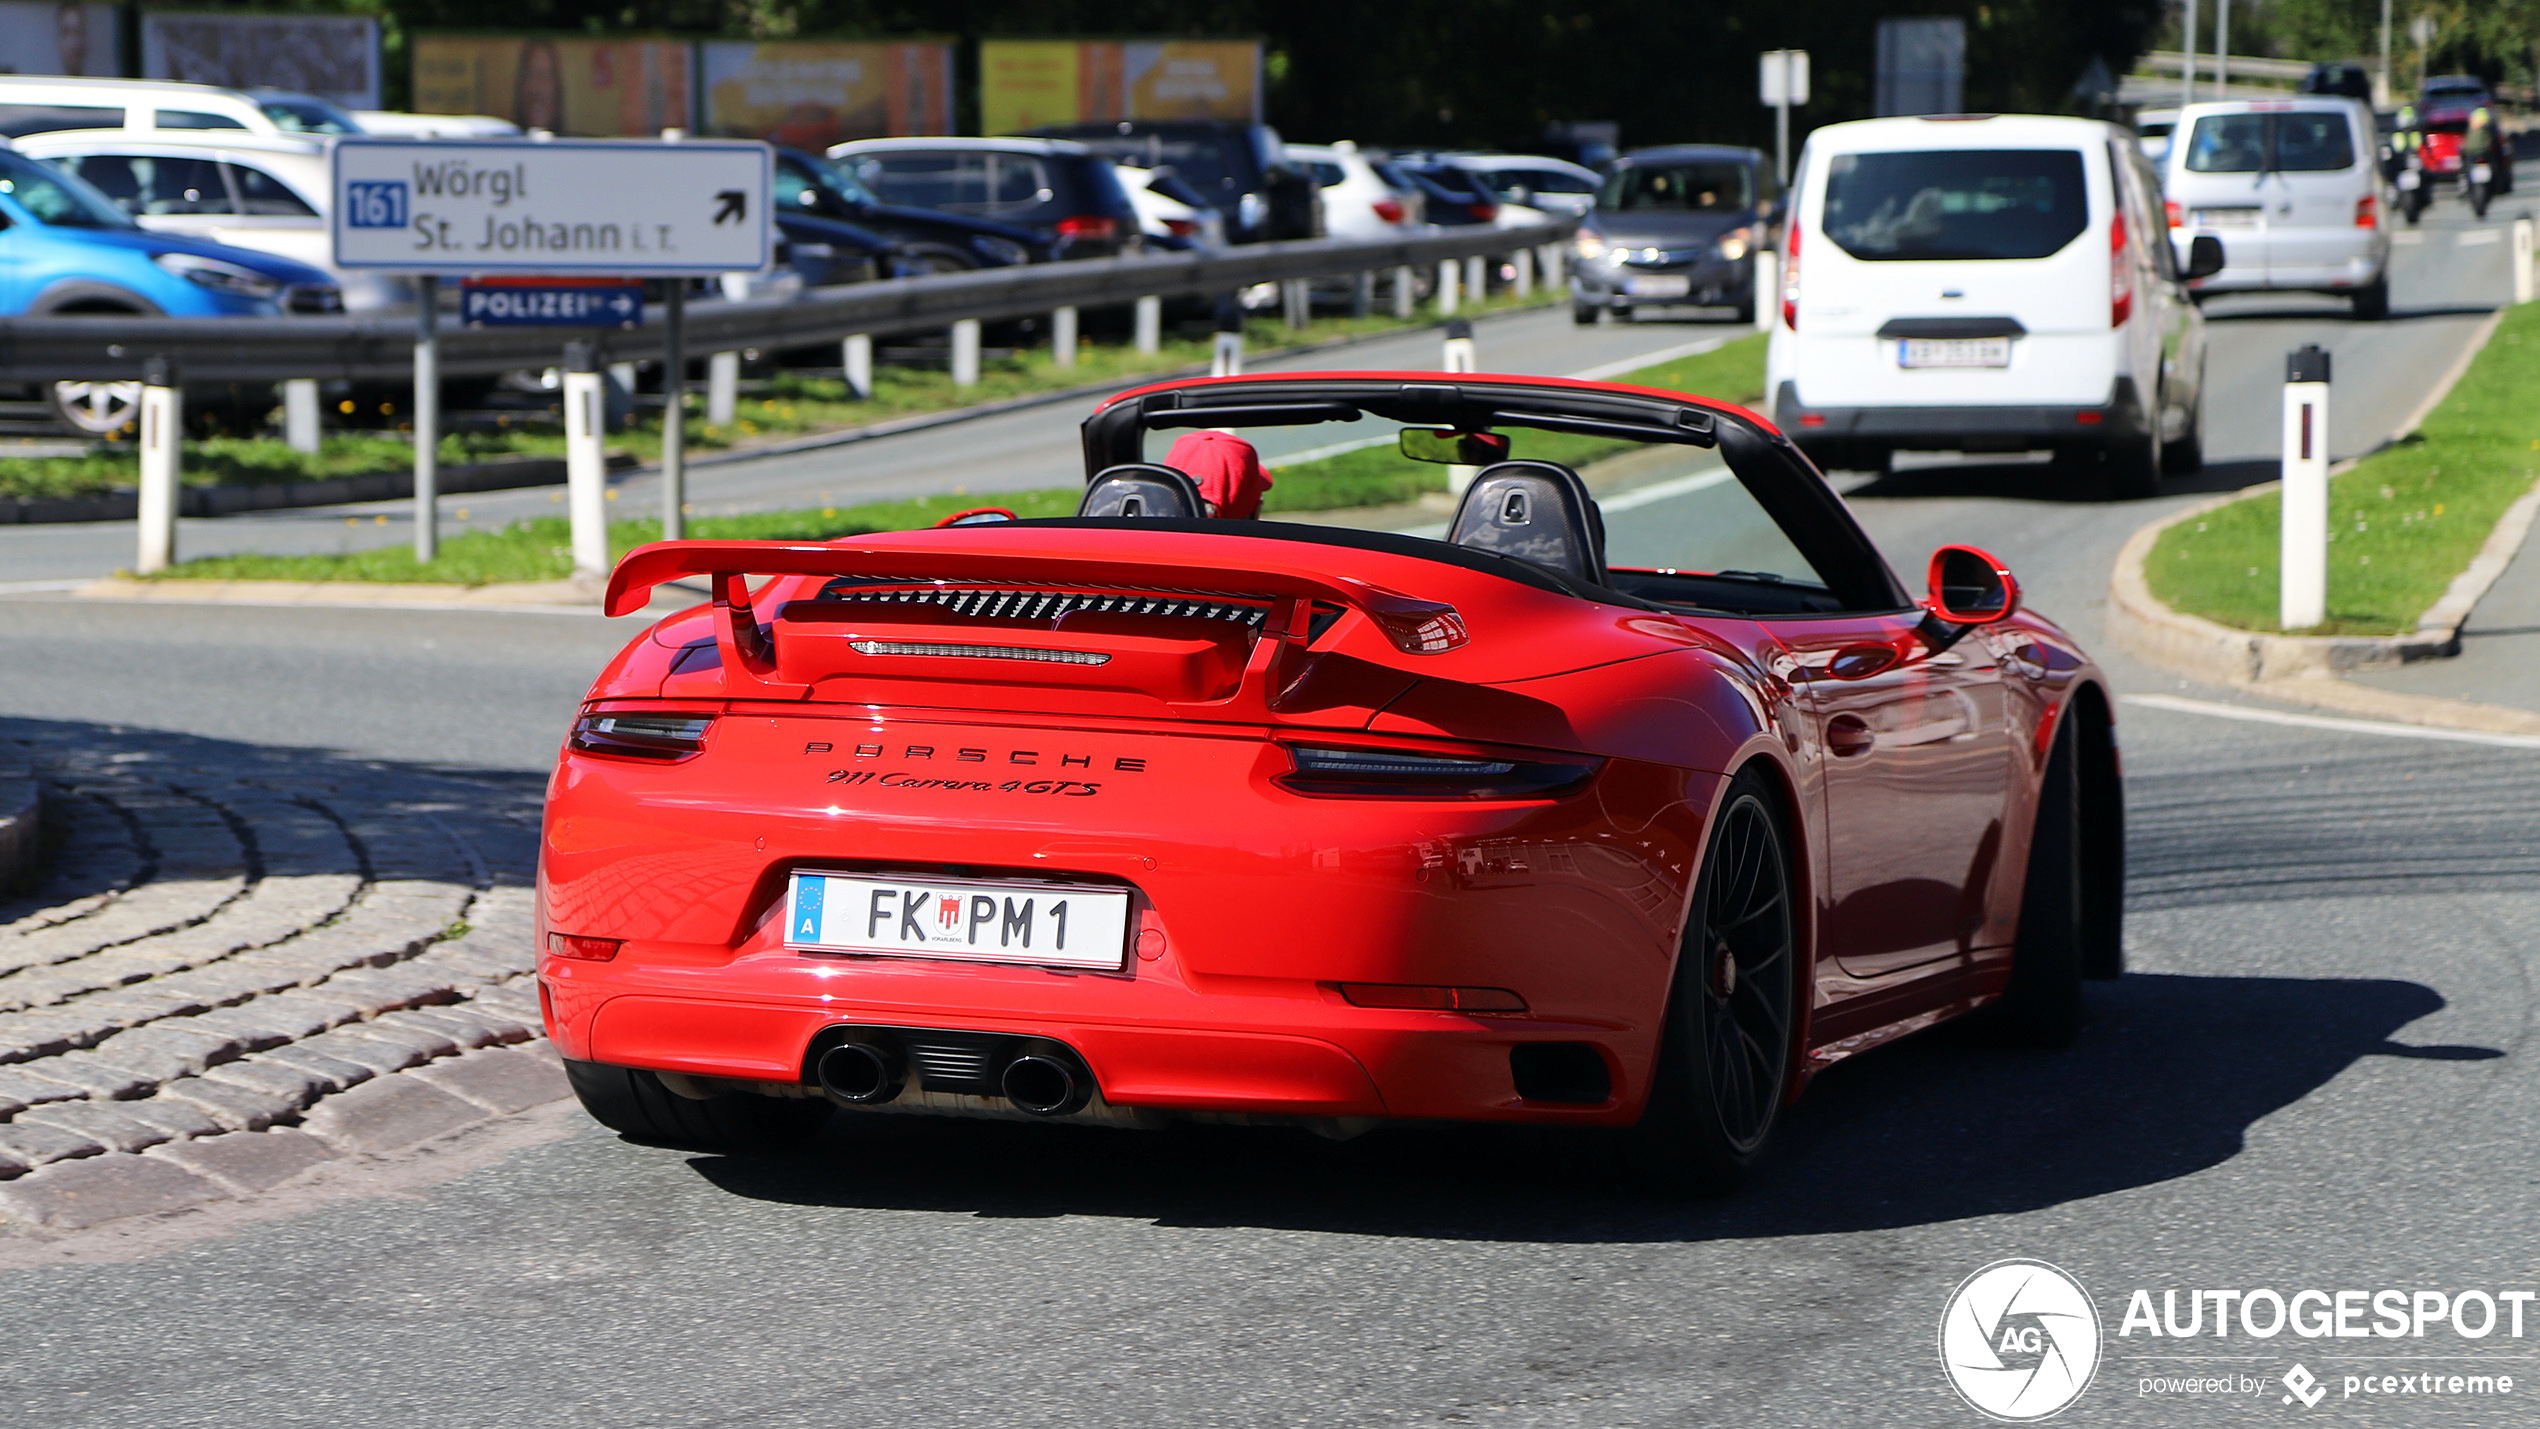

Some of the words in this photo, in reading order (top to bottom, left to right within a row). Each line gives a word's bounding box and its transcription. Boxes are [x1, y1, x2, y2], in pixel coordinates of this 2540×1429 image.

[413, 160, 526, 205] Wörgl
[351, 184, 403, 225] 161
[413, 213, 463, 251] St.
[477, 216, 621, 251] Johann
[633, 225, 648, 250] i.
[657, 224, 678, 251] T.
[469, 291, 588, 317] POLIZEI
[804, 742, 1147, 772] PORSCHE
[826, 769, 877, 785] 911
[879, 772, 992, 791] Carrera
[800, 919, 814, 934] A
[868, 889, 929, 941] FK
[968, 895, 1034, 947] PM
